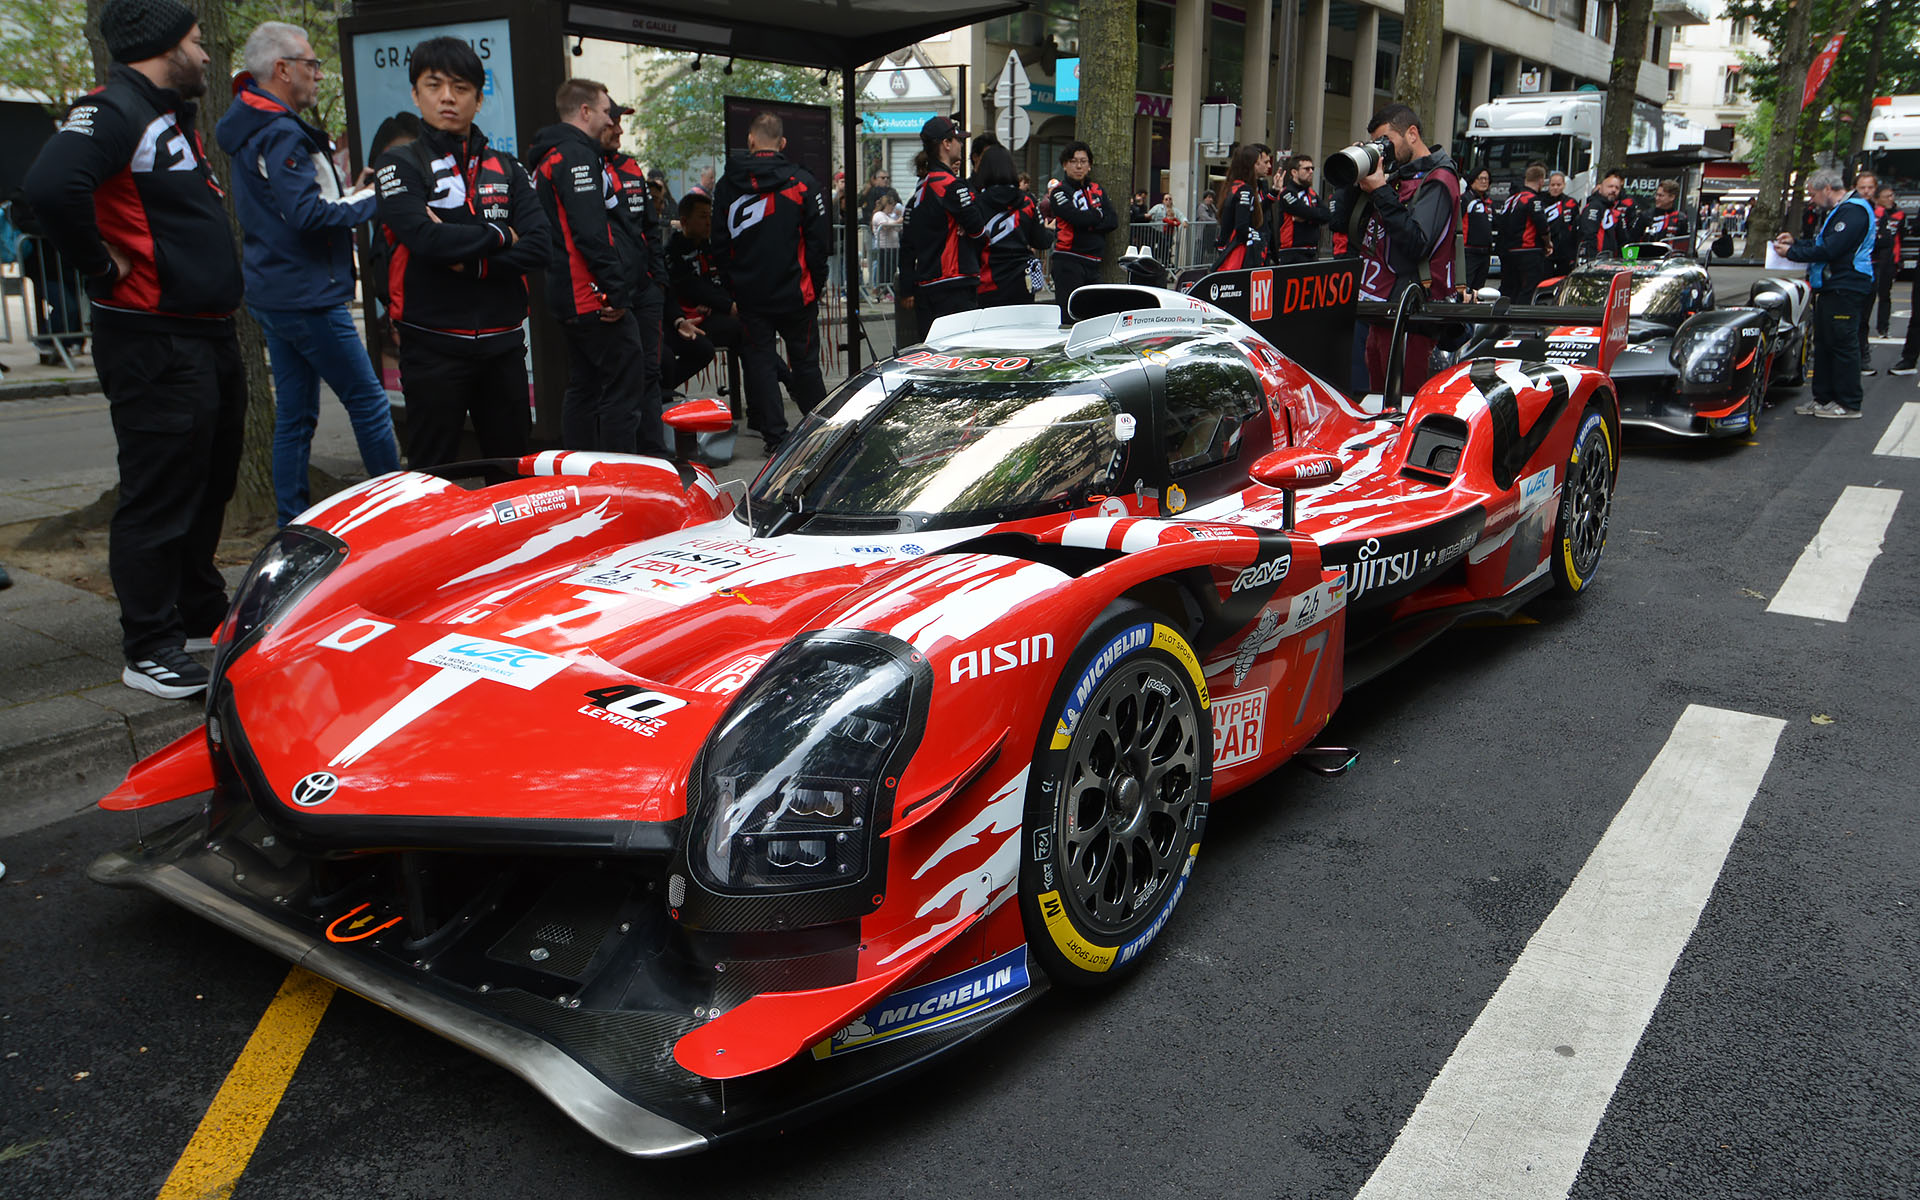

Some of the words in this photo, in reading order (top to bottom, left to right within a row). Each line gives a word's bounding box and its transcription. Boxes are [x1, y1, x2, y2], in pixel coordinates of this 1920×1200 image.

[632, 19, 643, 28] DE
[646, 21, 677, 33] GAULLE
[1627, 249, 1633, 257] 8
[1360, 258, 1381, 290] 12
[1252, 279, 1271, 313] HY
[1283, 271, 1353, 314] DENSO
[1612, 287, 1630, 309] JFE
[1176, 315, 1196, 325] Racing
[1570, 327, 1594, 337] 8
[1548, 342, 1594, 350] FUJITSU
[895, 351, 1031, 371] DENSO
[1525, 469, 1550, 498] WEC
[528, 489, 566, 501] TOYOTA
[532, 496, 566, 507] GAZOO
[534, 502, 568, 515] Racing
[650, 550, 742, 569] AISIN
[680, 538, 777, 560] FUJITSU
[629, 559, 708, 577] ZENT
[1231, 554, 1292, 593] RAYS
[447, 642, 550, 668] WEC
[950, 632, 1054, 685] AISIN
[1158, 631, 1176, 645] PILOT
[1177, 641, 1194, 664] SPORT
[1076, 628, 1147, 708] MICHELIN
[1294, 629, 1330, 727] 7
[577, 704, 602, 719] LE
[583, 684, 691, 719] 40
[1120, 880, 1184, 964] MICHELIN
[1066, 939, 1088, 961] SPORT
[1088, 955, 1110, 966] PILOT
[878, 965, 1012, 1027] MICHELIN
